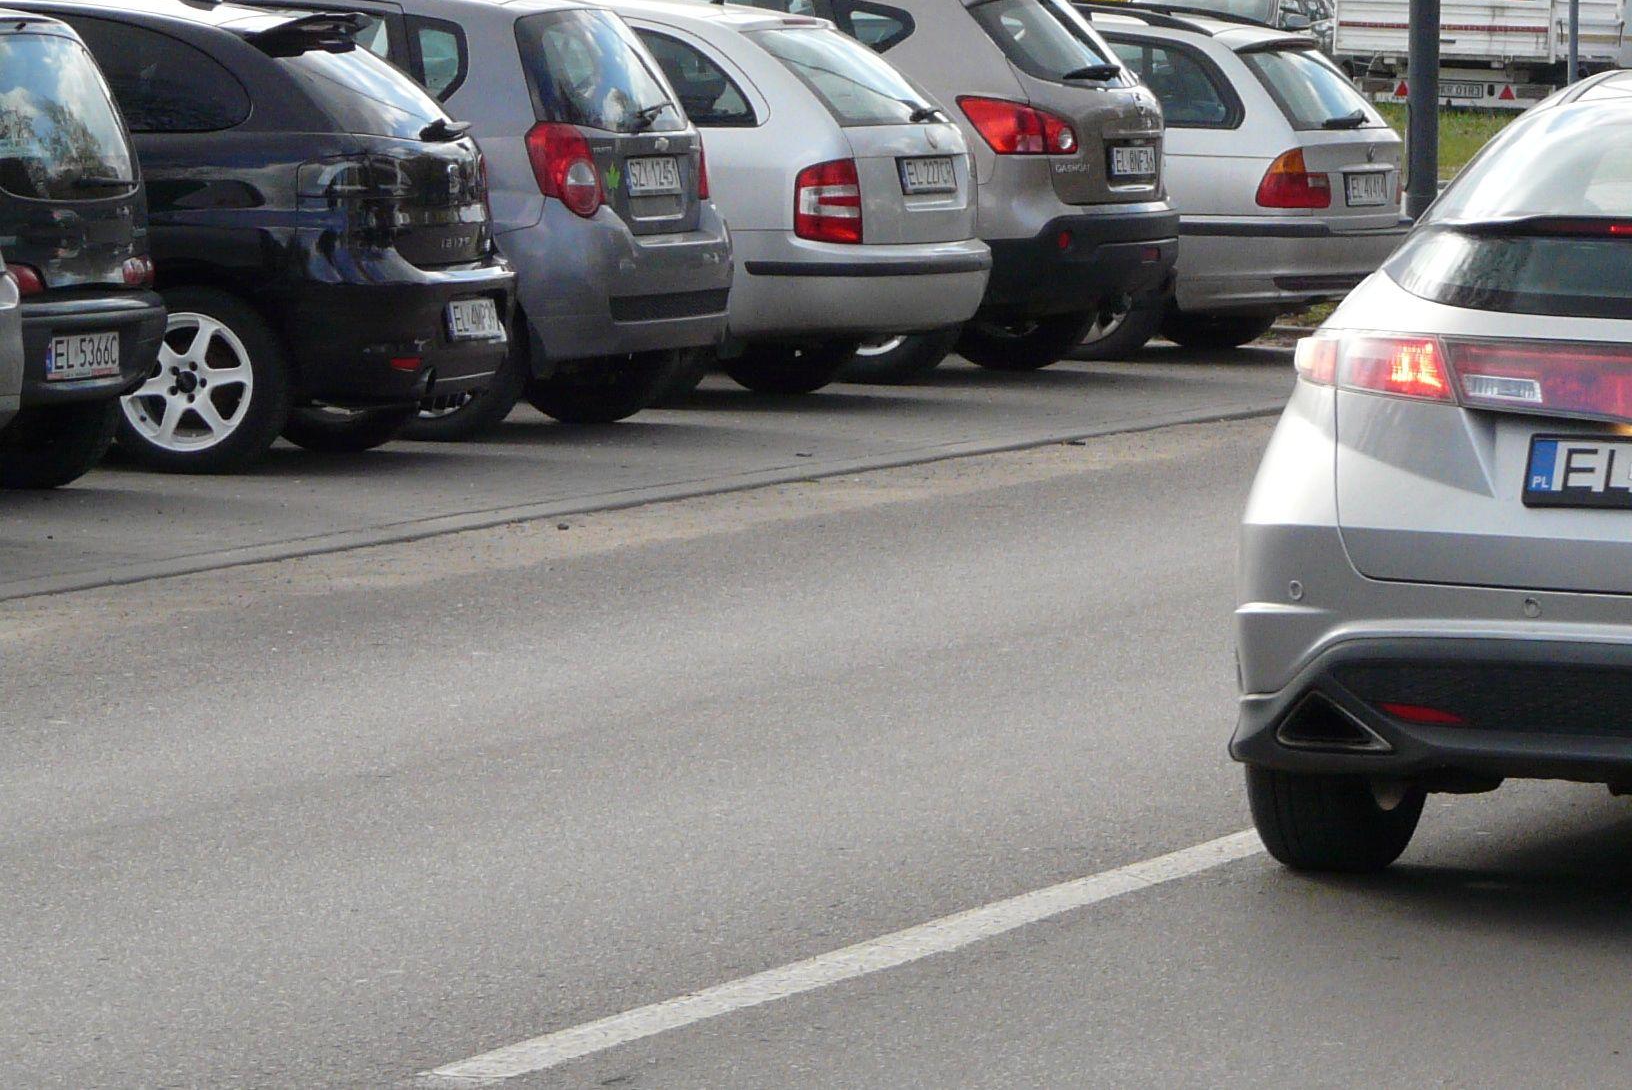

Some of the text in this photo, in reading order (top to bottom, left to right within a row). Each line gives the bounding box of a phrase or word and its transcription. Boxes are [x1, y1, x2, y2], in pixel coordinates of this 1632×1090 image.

[906, 162, 923, 185] EL
[54, 334, 118, 370] EL 5366C
[1532, 475, 1549, 489] PL
[1561, 448, 1630, 494] EL
